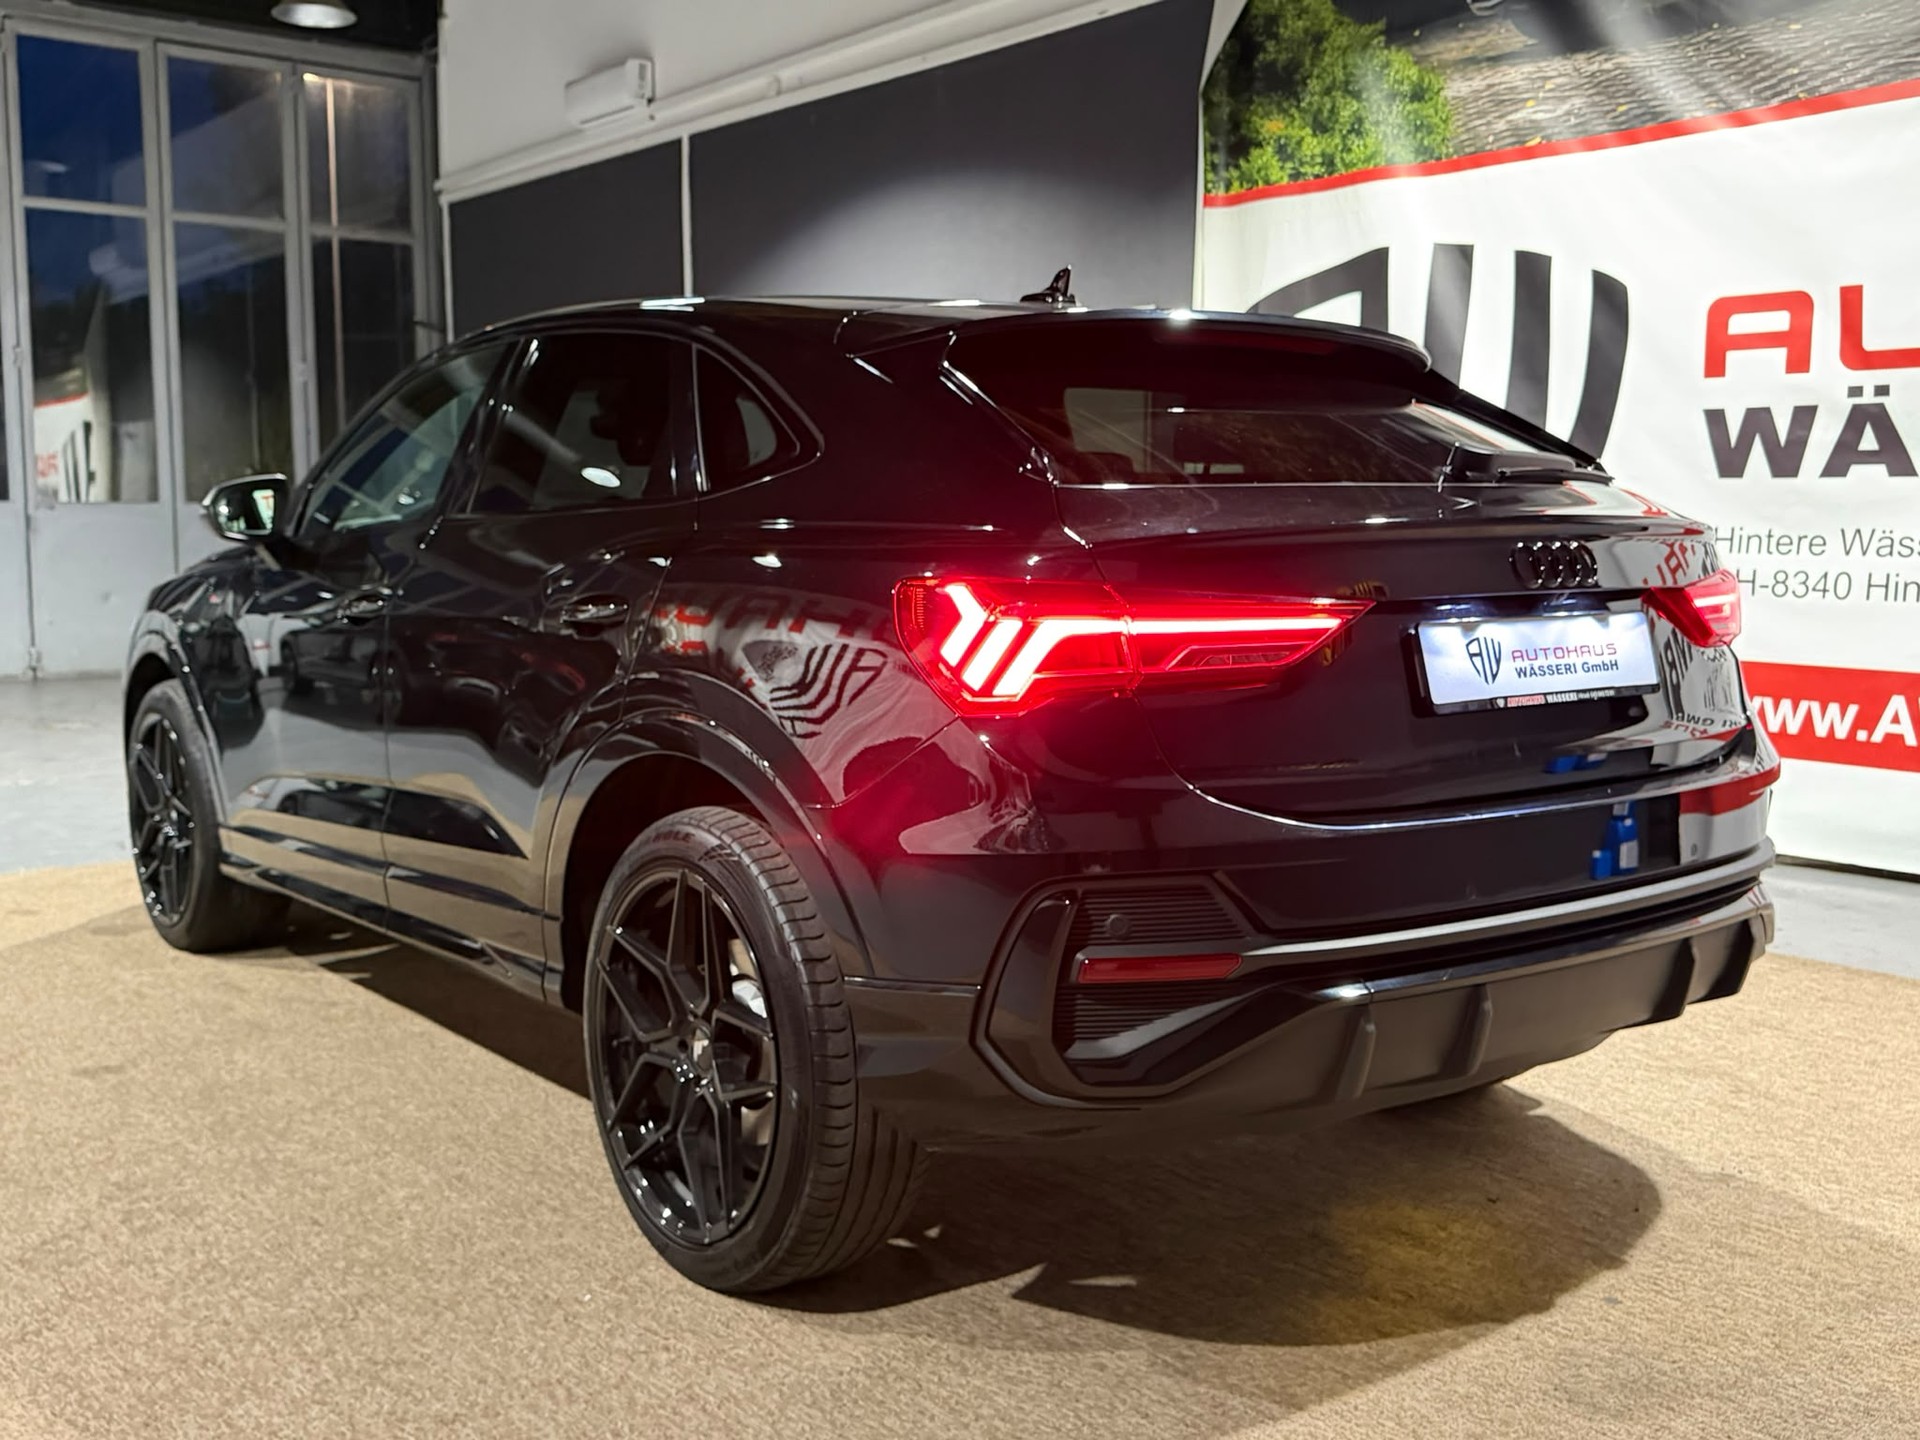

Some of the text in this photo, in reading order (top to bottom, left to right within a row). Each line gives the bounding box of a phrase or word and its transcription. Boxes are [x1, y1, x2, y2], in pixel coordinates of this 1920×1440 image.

[1714, 526, 1920, 558] Hintere Wäs
[1511, 643, 1617, 662] AUTOHAUS
[1514, 659, 1619, 679] WÄSSERI GmbH
